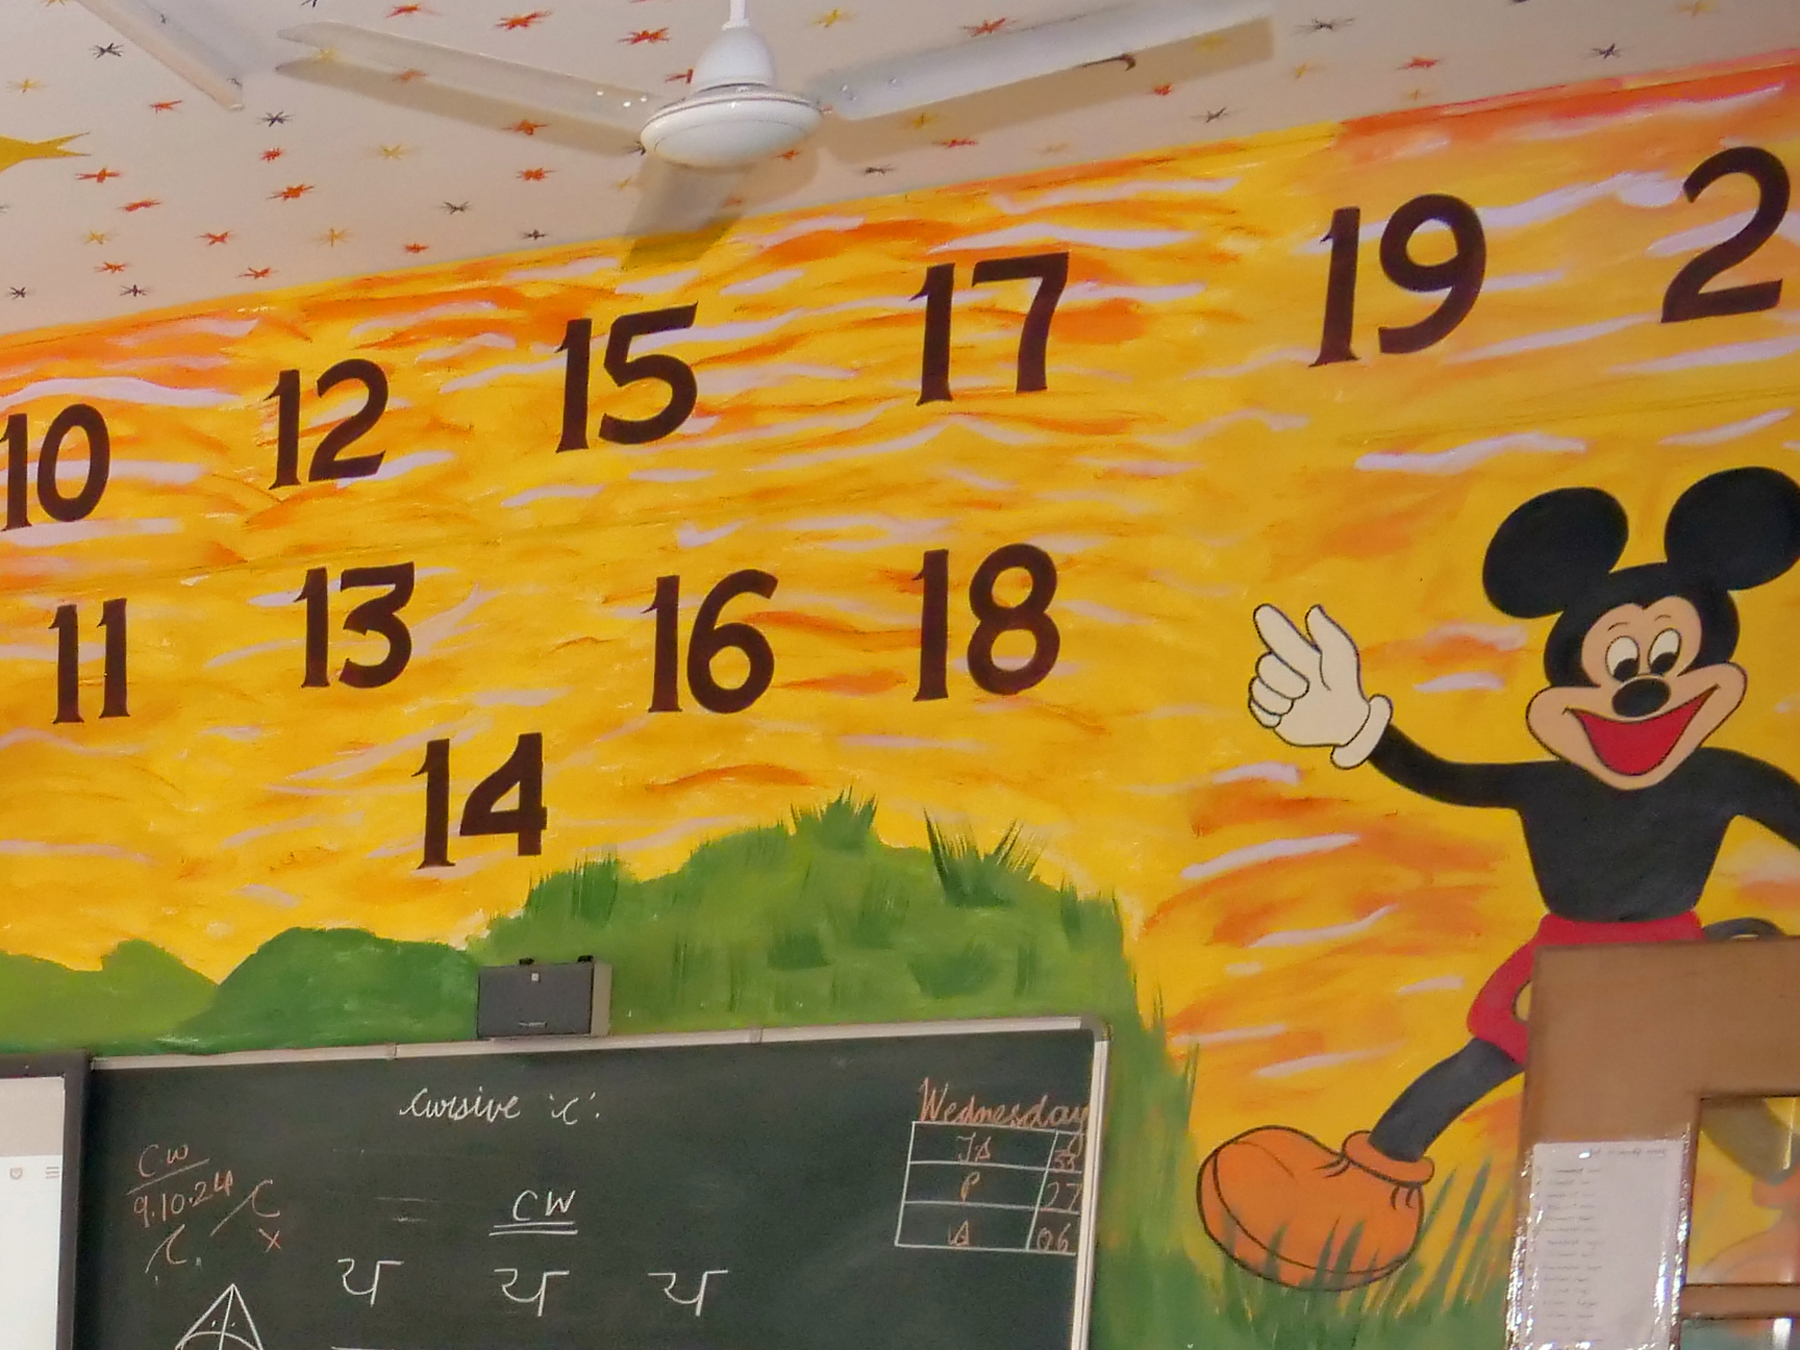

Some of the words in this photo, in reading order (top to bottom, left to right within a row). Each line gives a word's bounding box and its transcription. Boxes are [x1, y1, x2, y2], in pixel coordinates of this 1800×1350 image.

[912, 251, 1070, 406] 17
[1310, 194, 1487, 367] 19
[268, 359, 388, 490] 12
[555, 303, 699, 455] 15
[50, 599, 130, 724] 11
[295, 562, 414, 688] 13
[644, 569, 778, 714] 16
[913, 543, 1061, 700] 18
[414, 732, 547, 867] 14
[919, 1077, 1089, 1154] Wednesday
